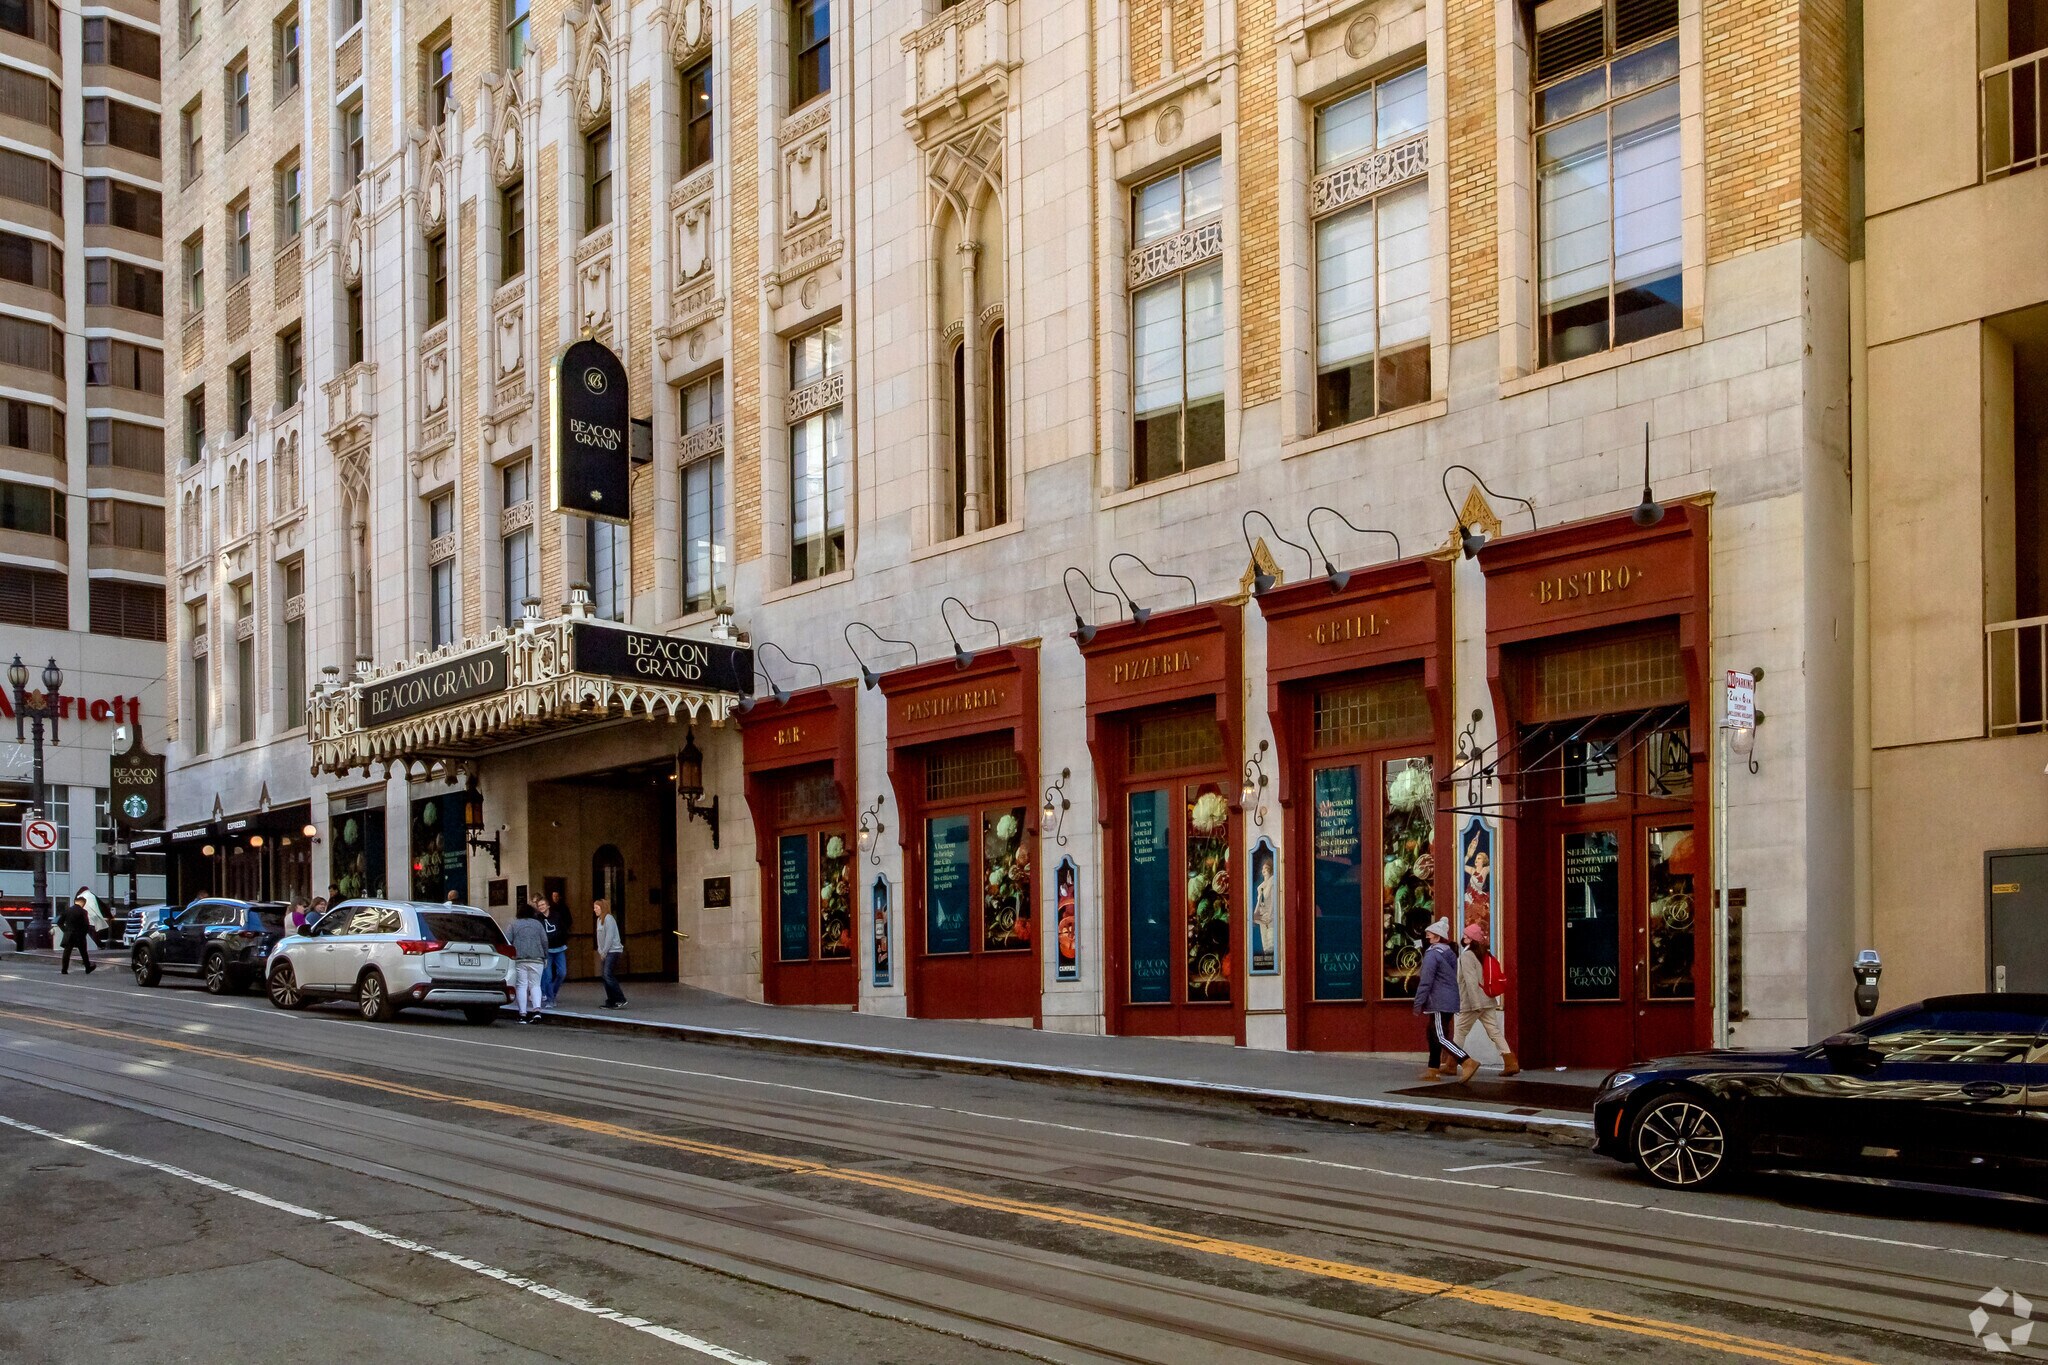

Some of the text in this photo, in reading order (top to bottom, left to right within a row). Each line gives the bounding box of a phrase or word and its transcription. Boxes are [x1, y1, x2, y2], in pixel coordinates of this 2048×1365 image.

[571, 418, 621, 443] BEACON
[575, 432, 618, 451] GRAND
[1540, 565, 1630, 604] BISTRO
[1316, 613, 1380, 644] GRILL
[627, 635, 708, 666] BEACON
[636, 657, 701, 680] GRAND
[1114, 650, 1191, 684] PIZZERIA
[1728, 672, 1753, 690] NO PARKING
[372, 659, 494, 715] BEACON GRAND
[0, 683, 140, 724] riott
[907, 688, 997, 721] PASTICCERIA
[778, 726, 800, 746] BAR
[113, 767, 158, 778] BEACON
[118, 777, 153, 785] GRAND
[1320, 799, 1353, 808] A beacon
[1328, 808, 1352, 817] bridge
[1332, 818, 1347, 827] City
[1134, 828, 1152, 836] social
[1320, 826, 1354, 837] and all of
[1134, 838, 1151, 846] circle
[1320, 837, 1358, 847] its citizens
[1320, 847, 1349, 857] in spirit
[1567, 848, 1602, 857] SEEKING
[1135, 856, 1156, 865] Square
[1567, 856, 1618, 865] HOSPITALITY
[1320, 952, 1360, 964] BEACON
[1134, 959, 1168, 970] BEACON
[1323, 962, 1356, 972] GRAND
[1137, 969, 1165, 977] GRAND
[1569, 966, 1617, 978] BEACON
[1573, 976, 1613, 987] GRAND
